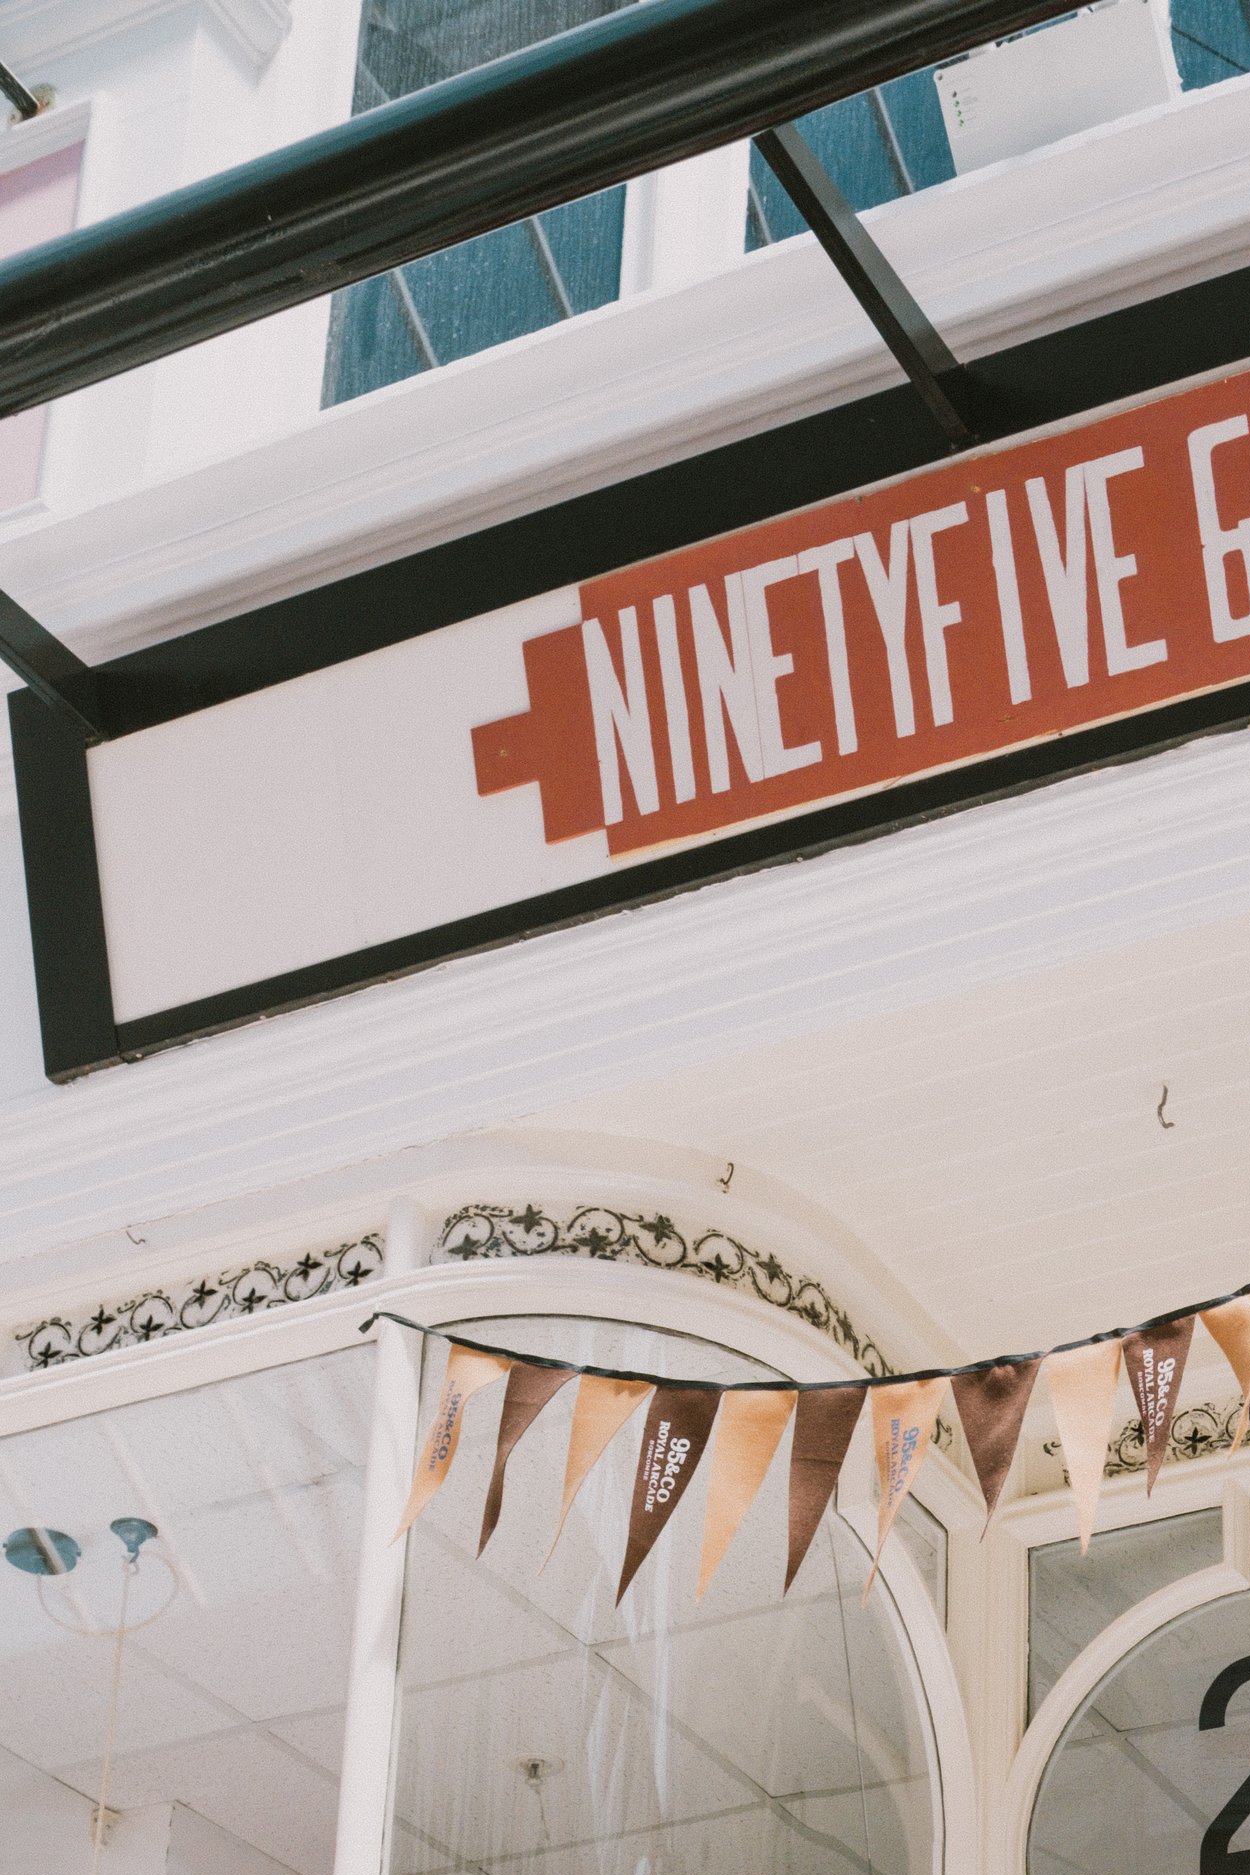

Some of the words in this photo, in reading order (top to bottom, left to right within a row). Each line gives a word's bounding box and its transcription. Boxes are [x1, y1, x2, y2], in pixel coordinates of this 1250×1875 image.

[582, 446, 1168, 826] NINETYFIVE
[1142, 1348, 1155, 1391] ROYAL
[1155, 1357, 1176, 1427] 95&CO
[654, 1420, 671, 1460] ROYAL
[1146, 1393, 1156, 1443] ARCADE
[645, 1462, 662, 1513] ARCADE
[656, 1437, 691, 1503] 95&CO
